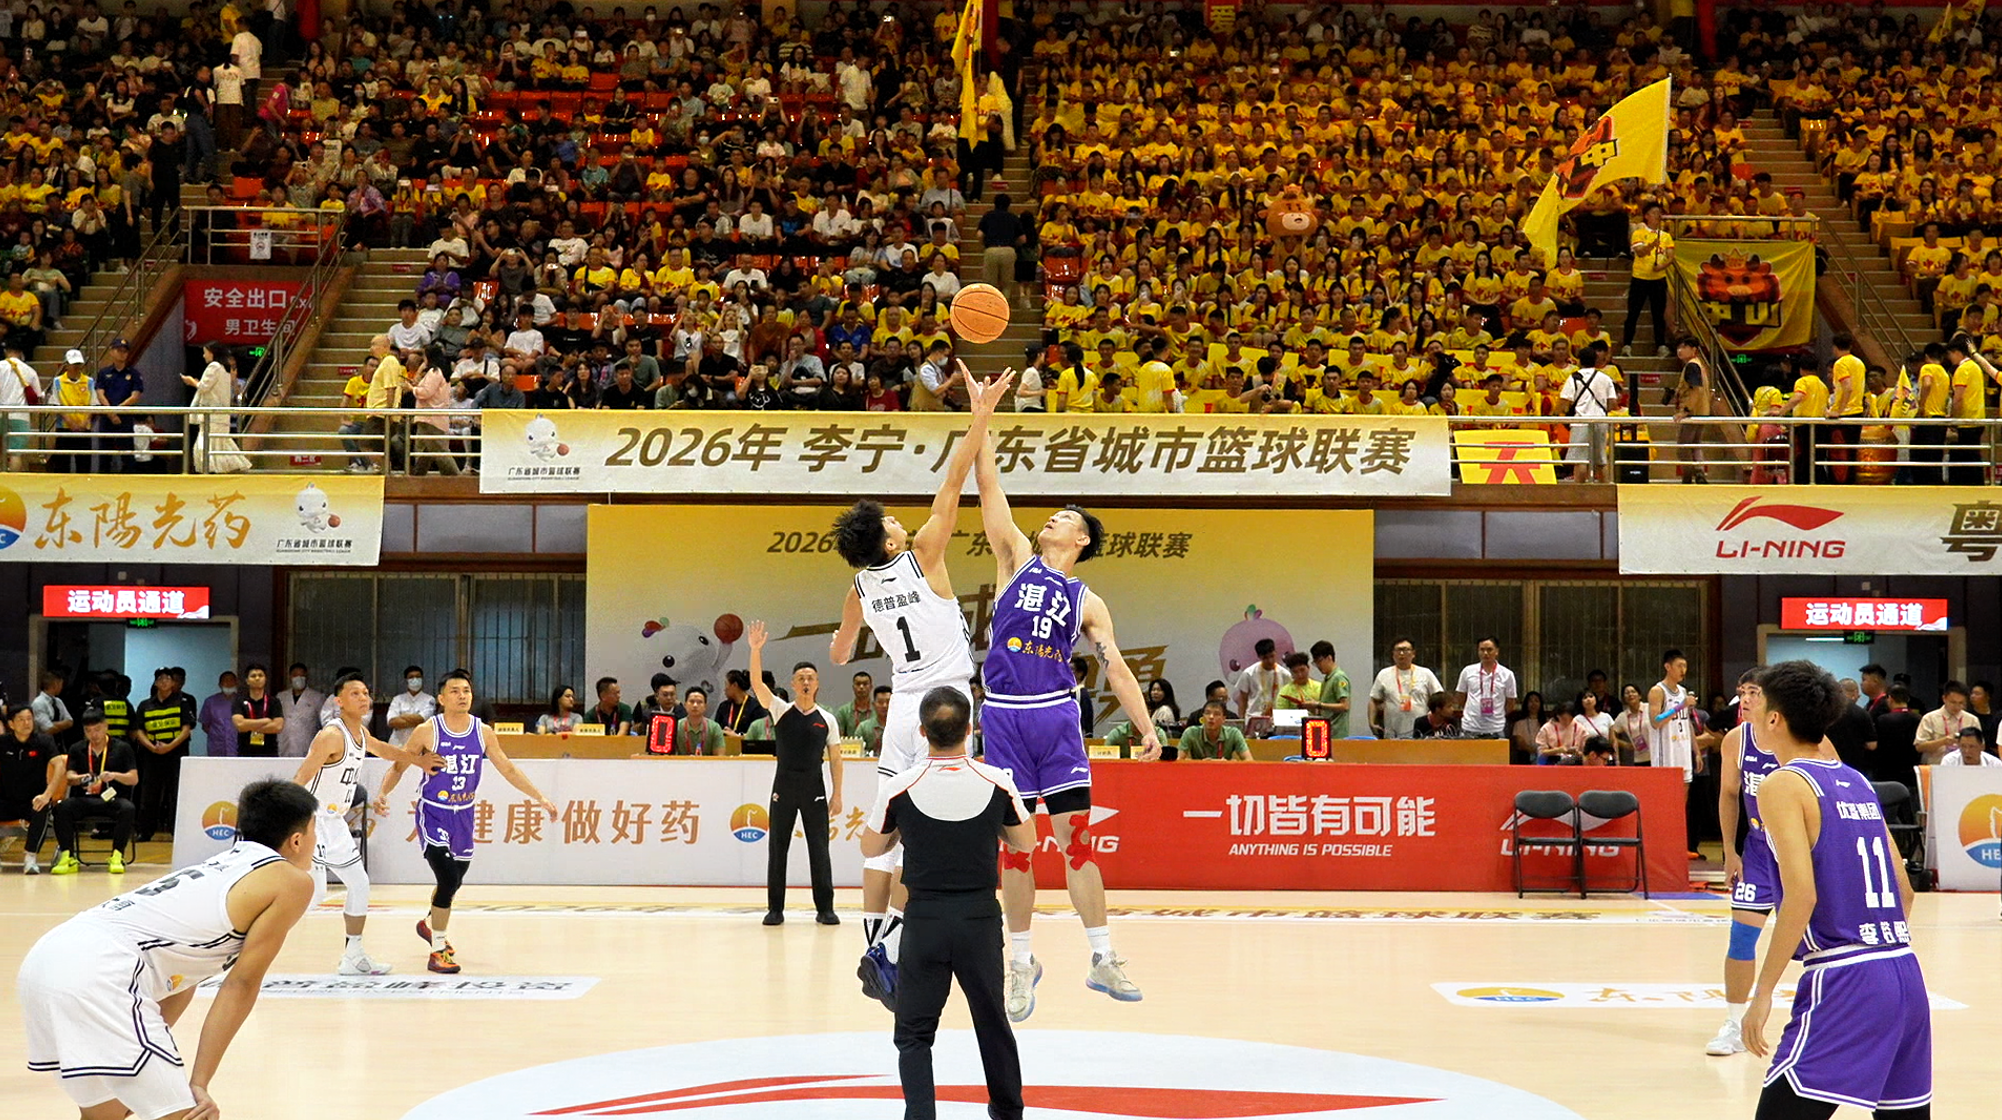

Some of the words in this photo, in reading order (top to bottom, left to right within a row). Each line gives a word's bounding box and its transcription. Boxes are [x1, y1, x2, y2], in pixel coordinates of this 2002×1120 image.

[204, 287, 287, 309] 安全出口
[225, 319, 297, 336] 男卫生间
[604, 423, 788, 472] 2026年
[767, 532, 838, 553] 2026
[1715, 540, 1846, 559] LI-NING
[67, 590, 185, 614] 运动员通道
[871, 590, 922, 613] 德普盈峰
[1015, 582, 1072, 628] 湛江
[1806, 603, 1923, 626] 运动员通道
[1032, 615, 1053, 639] 19
[896, 616, 921, 663] 1
[651, 714, 675, 753] 0
[1305, 719, 1329, 758] 0
[1183, 794, 1436, 837] 一切皆有可能
[741, 831, 759, 840] HEC
[1228, 843, 1299, 856] ANYTHING
[1303, 843, 1318, 856] IS
[1321, 843, 1393, 858] POSSIBLE
[1856, 836, 1896, 908] 11
[1734, 882, 1757, 902] 26
